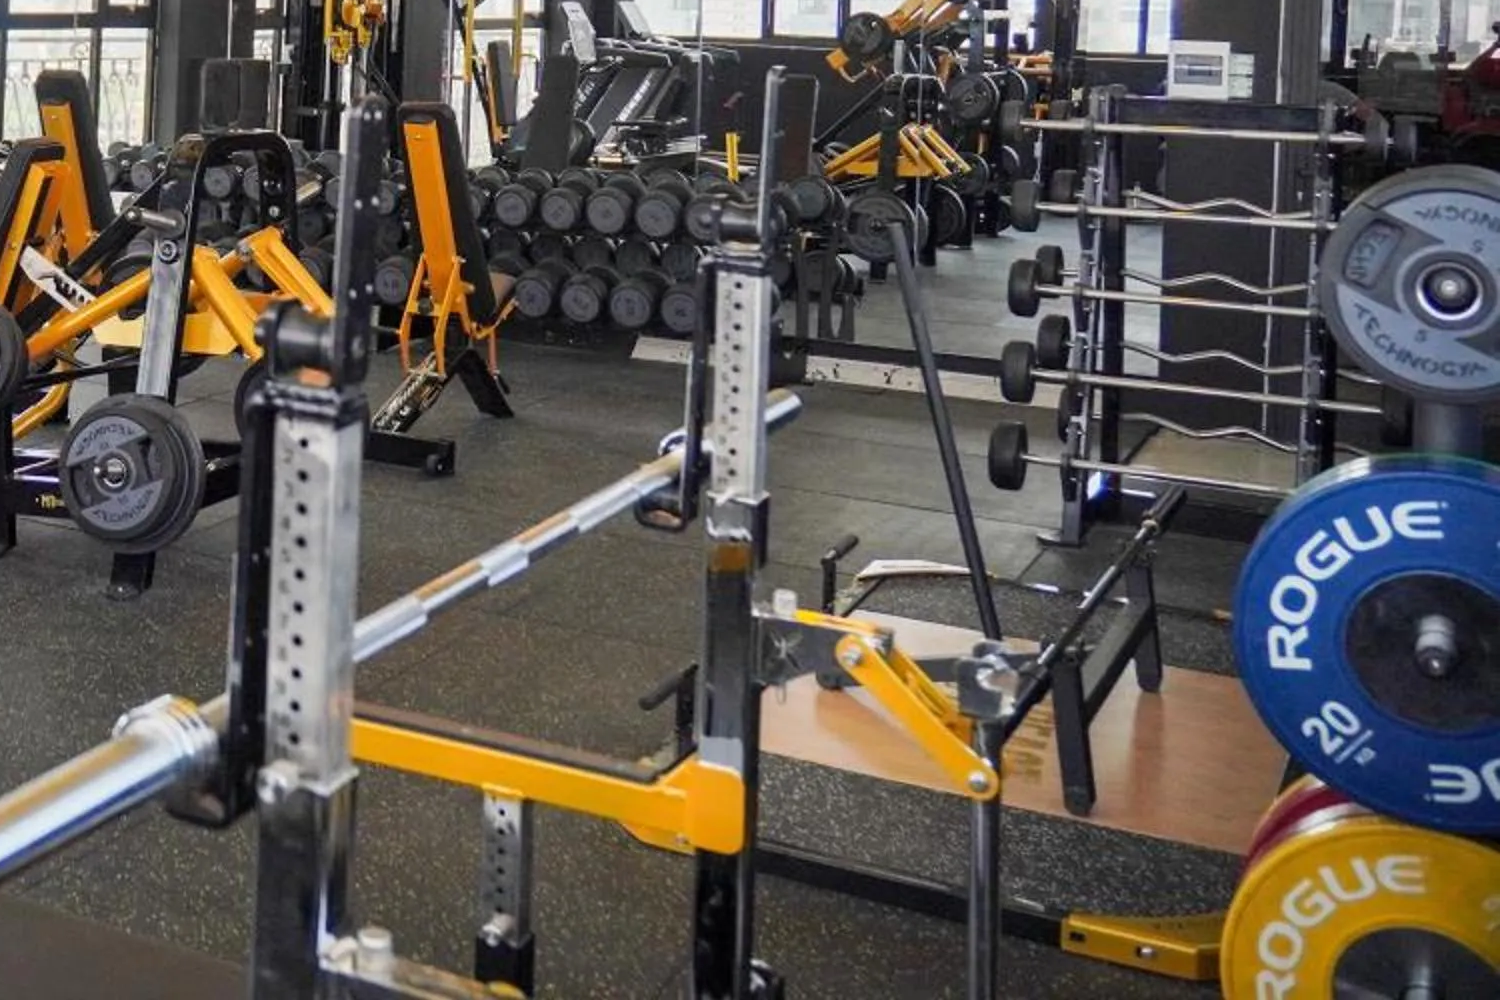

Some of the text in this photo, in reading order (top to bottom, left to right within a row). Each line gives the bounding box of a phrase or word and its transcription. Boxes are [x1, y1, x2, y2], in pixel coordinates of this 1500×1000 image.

[1267, 501, 1445, 671] ROGUE
[1301, 701, 1361, 756] 20
[1255, 854, 1427, 1000] ROGUE
